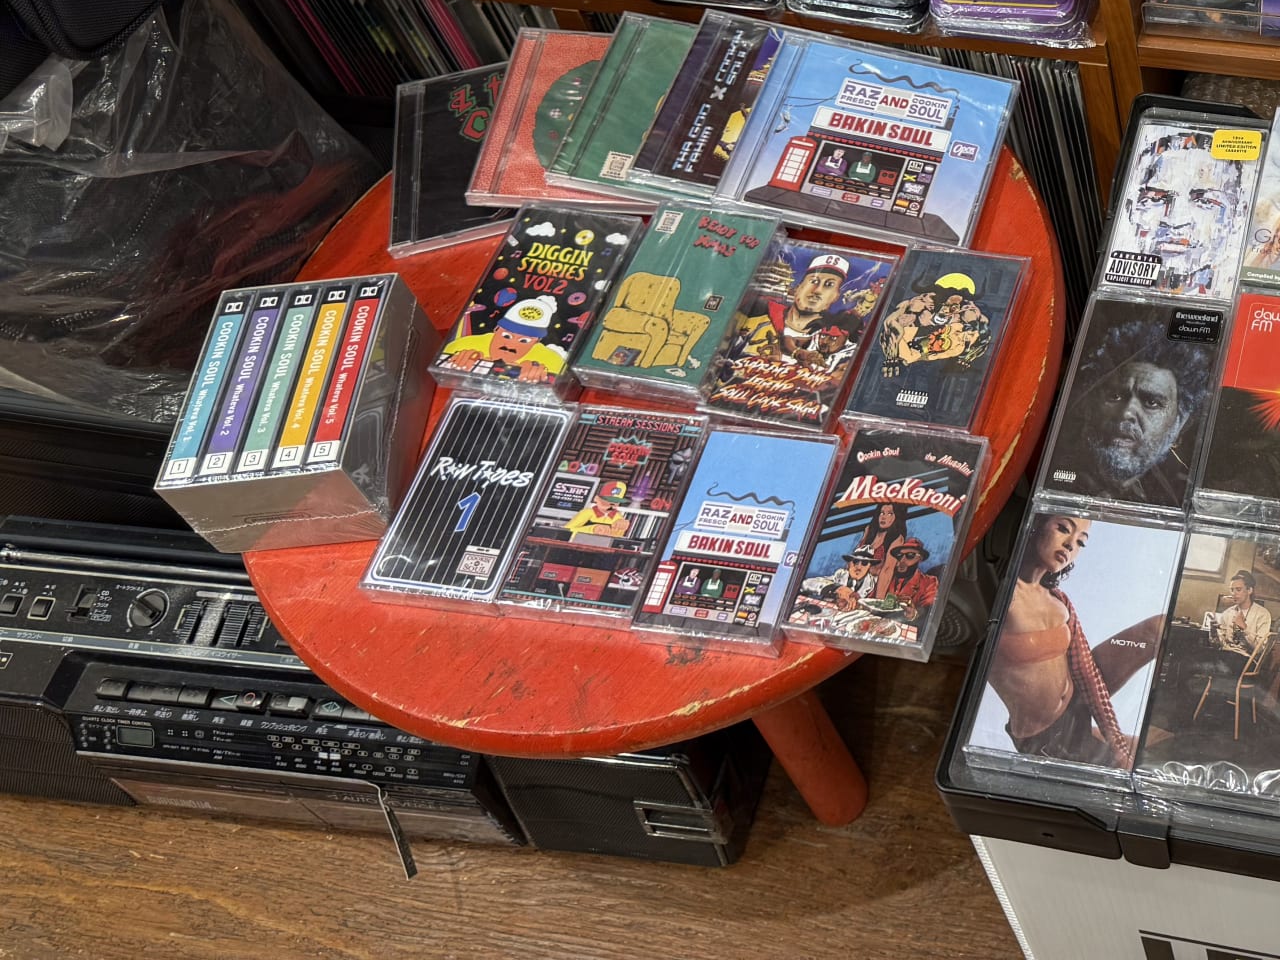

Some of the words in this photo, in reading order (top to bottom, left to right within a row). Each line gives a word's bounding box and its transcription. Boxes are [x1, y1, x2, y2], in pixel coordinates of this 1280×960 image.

[842, 82, 882, 102] RAZ
[840, 94, 877, 108] FRESCO
[878, 94, 910, 110] AND
[911, 96, 948, 110] COOKIN
[908, 104, 944, 121] SOUL
[828, 112, 888, 137] BAKIN
[889, 122, 933, 146] SOUL
[954, 142, 976, 156] Open
[526, 241, 593, 266] DIGGIN
[1110, 250, 1162, 264] PARENTAL
[1251, 246, 1274, 255] Free
[825, 256, 841, 266] CS
[516, 256, 588, 282] STORIES
[1107, 259, 1161, 279] ADVISORY
[1105, 272, 1129, 283] EXPLICIT
[1130, 276, 1154, 286] CONTENT
[1250, 320, 1274, 334] FM
[247, 316, 270, 353] COOKIN
[238, 354, 257, 381] SOUL
[230, 383, 246, 412] Whateva
[596, 414, 634, 427] STREAM
[634, 418, 682, 434] SESSIONS
[318, 445, 326, 454] 5
[856, 449, 882, 464] Cookin
[882, 446, 900, 458] Soul
[177, 462, 182, 472] 1
[214, 457, 220, 466] 2
[455, 492, 481, 532] 1
[700, 506, 733, 520] RAZ
[729, 512, 754, 526] AND
[756, 512, 785, 522] COOKIN
[698, 516, 728, 526] FRESCO
[752, 518, 782, 532] SOUL
[686, 534, 733, 554] BAKIN
[734, 539, 771, 559] SOUL
[1110, 638, 1147, 649] MOTIVE
